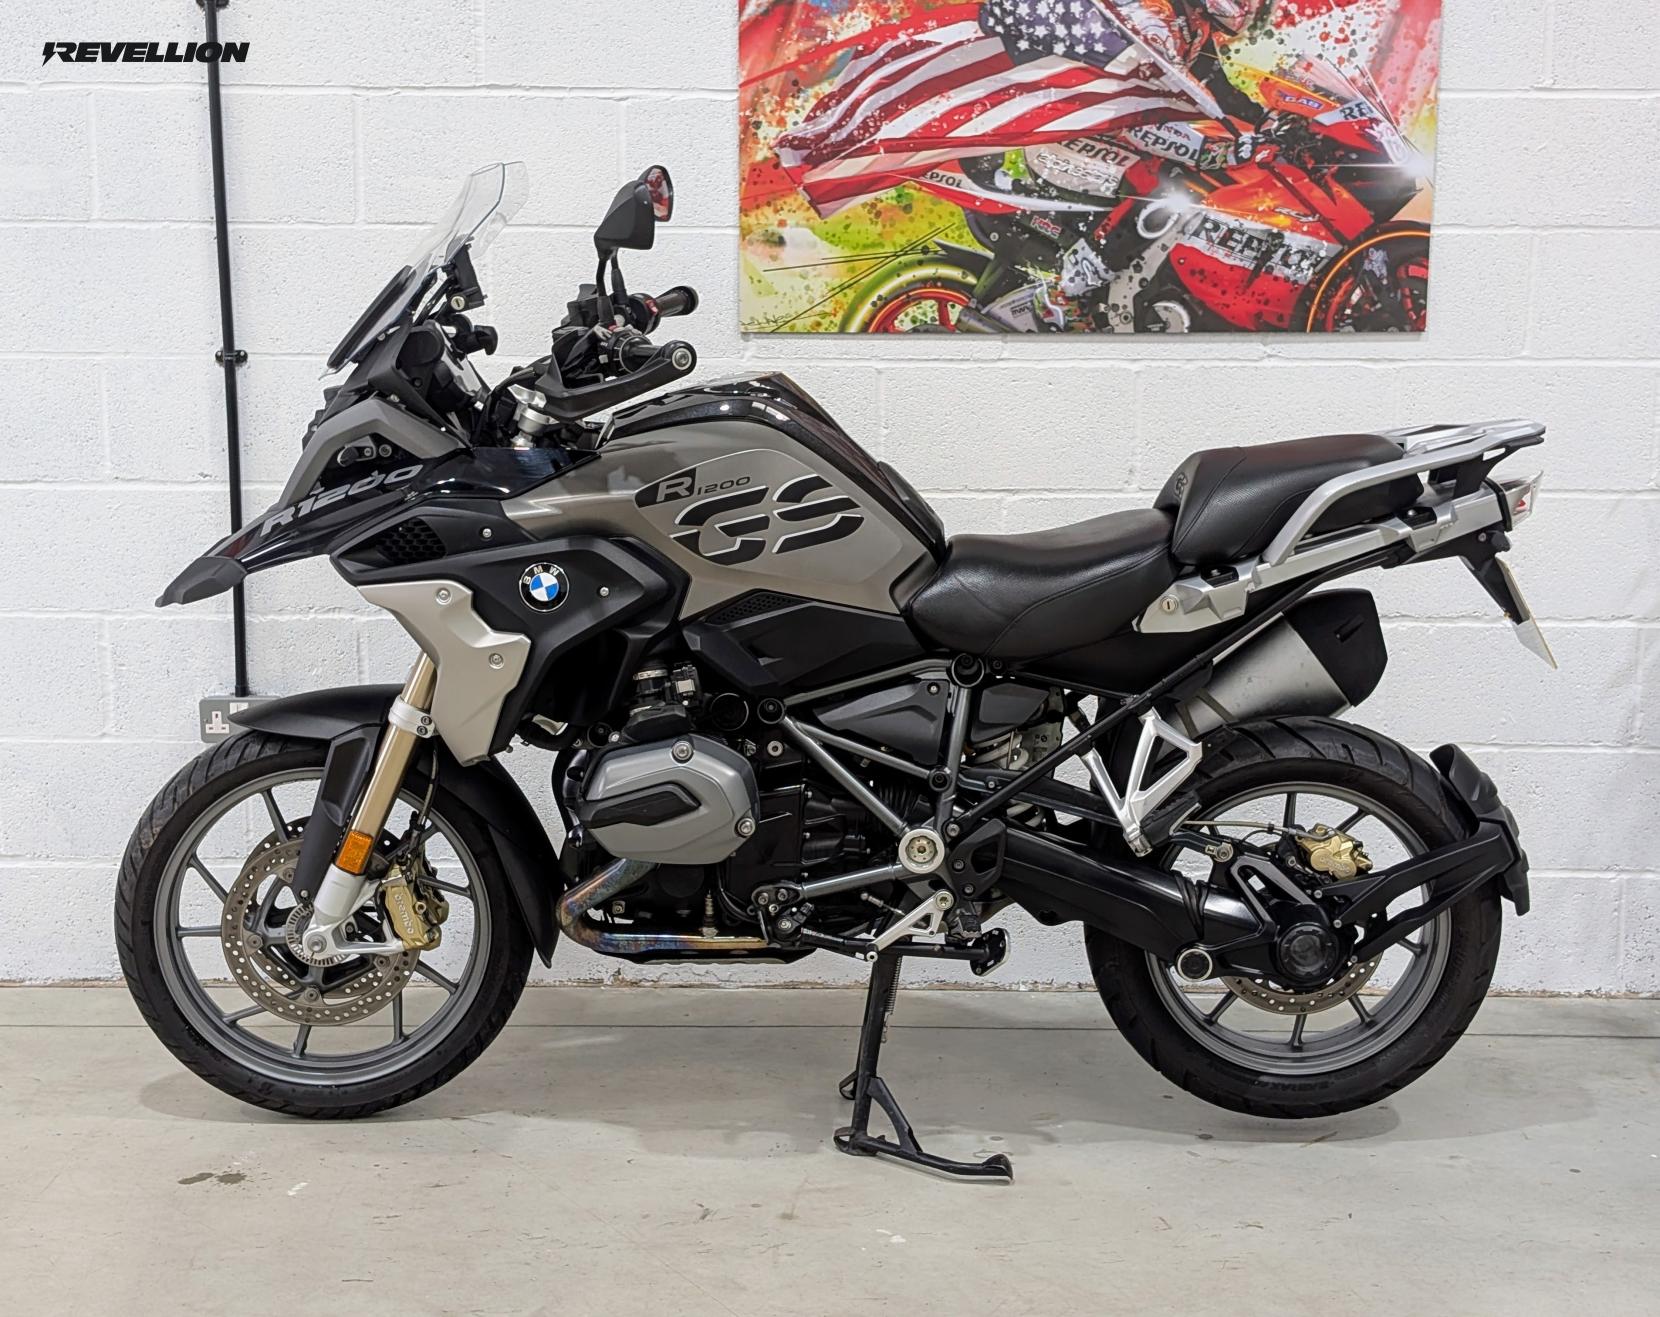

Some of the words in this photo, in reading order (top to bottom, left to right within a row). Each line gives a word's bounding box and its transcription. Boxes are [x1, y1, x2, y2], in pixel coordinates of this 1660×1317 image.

[1057, 139, 1132, 167] EPSOL
[1127, 126, 1200, 163] REPSOL
[260, 464, 424, 537] R1200
[697, 476, 752, 496] 1200
[669, 473, 865, 567] GS
[522, 564, 560, 585] BMW
[394, 892, 415, 935] brembo
